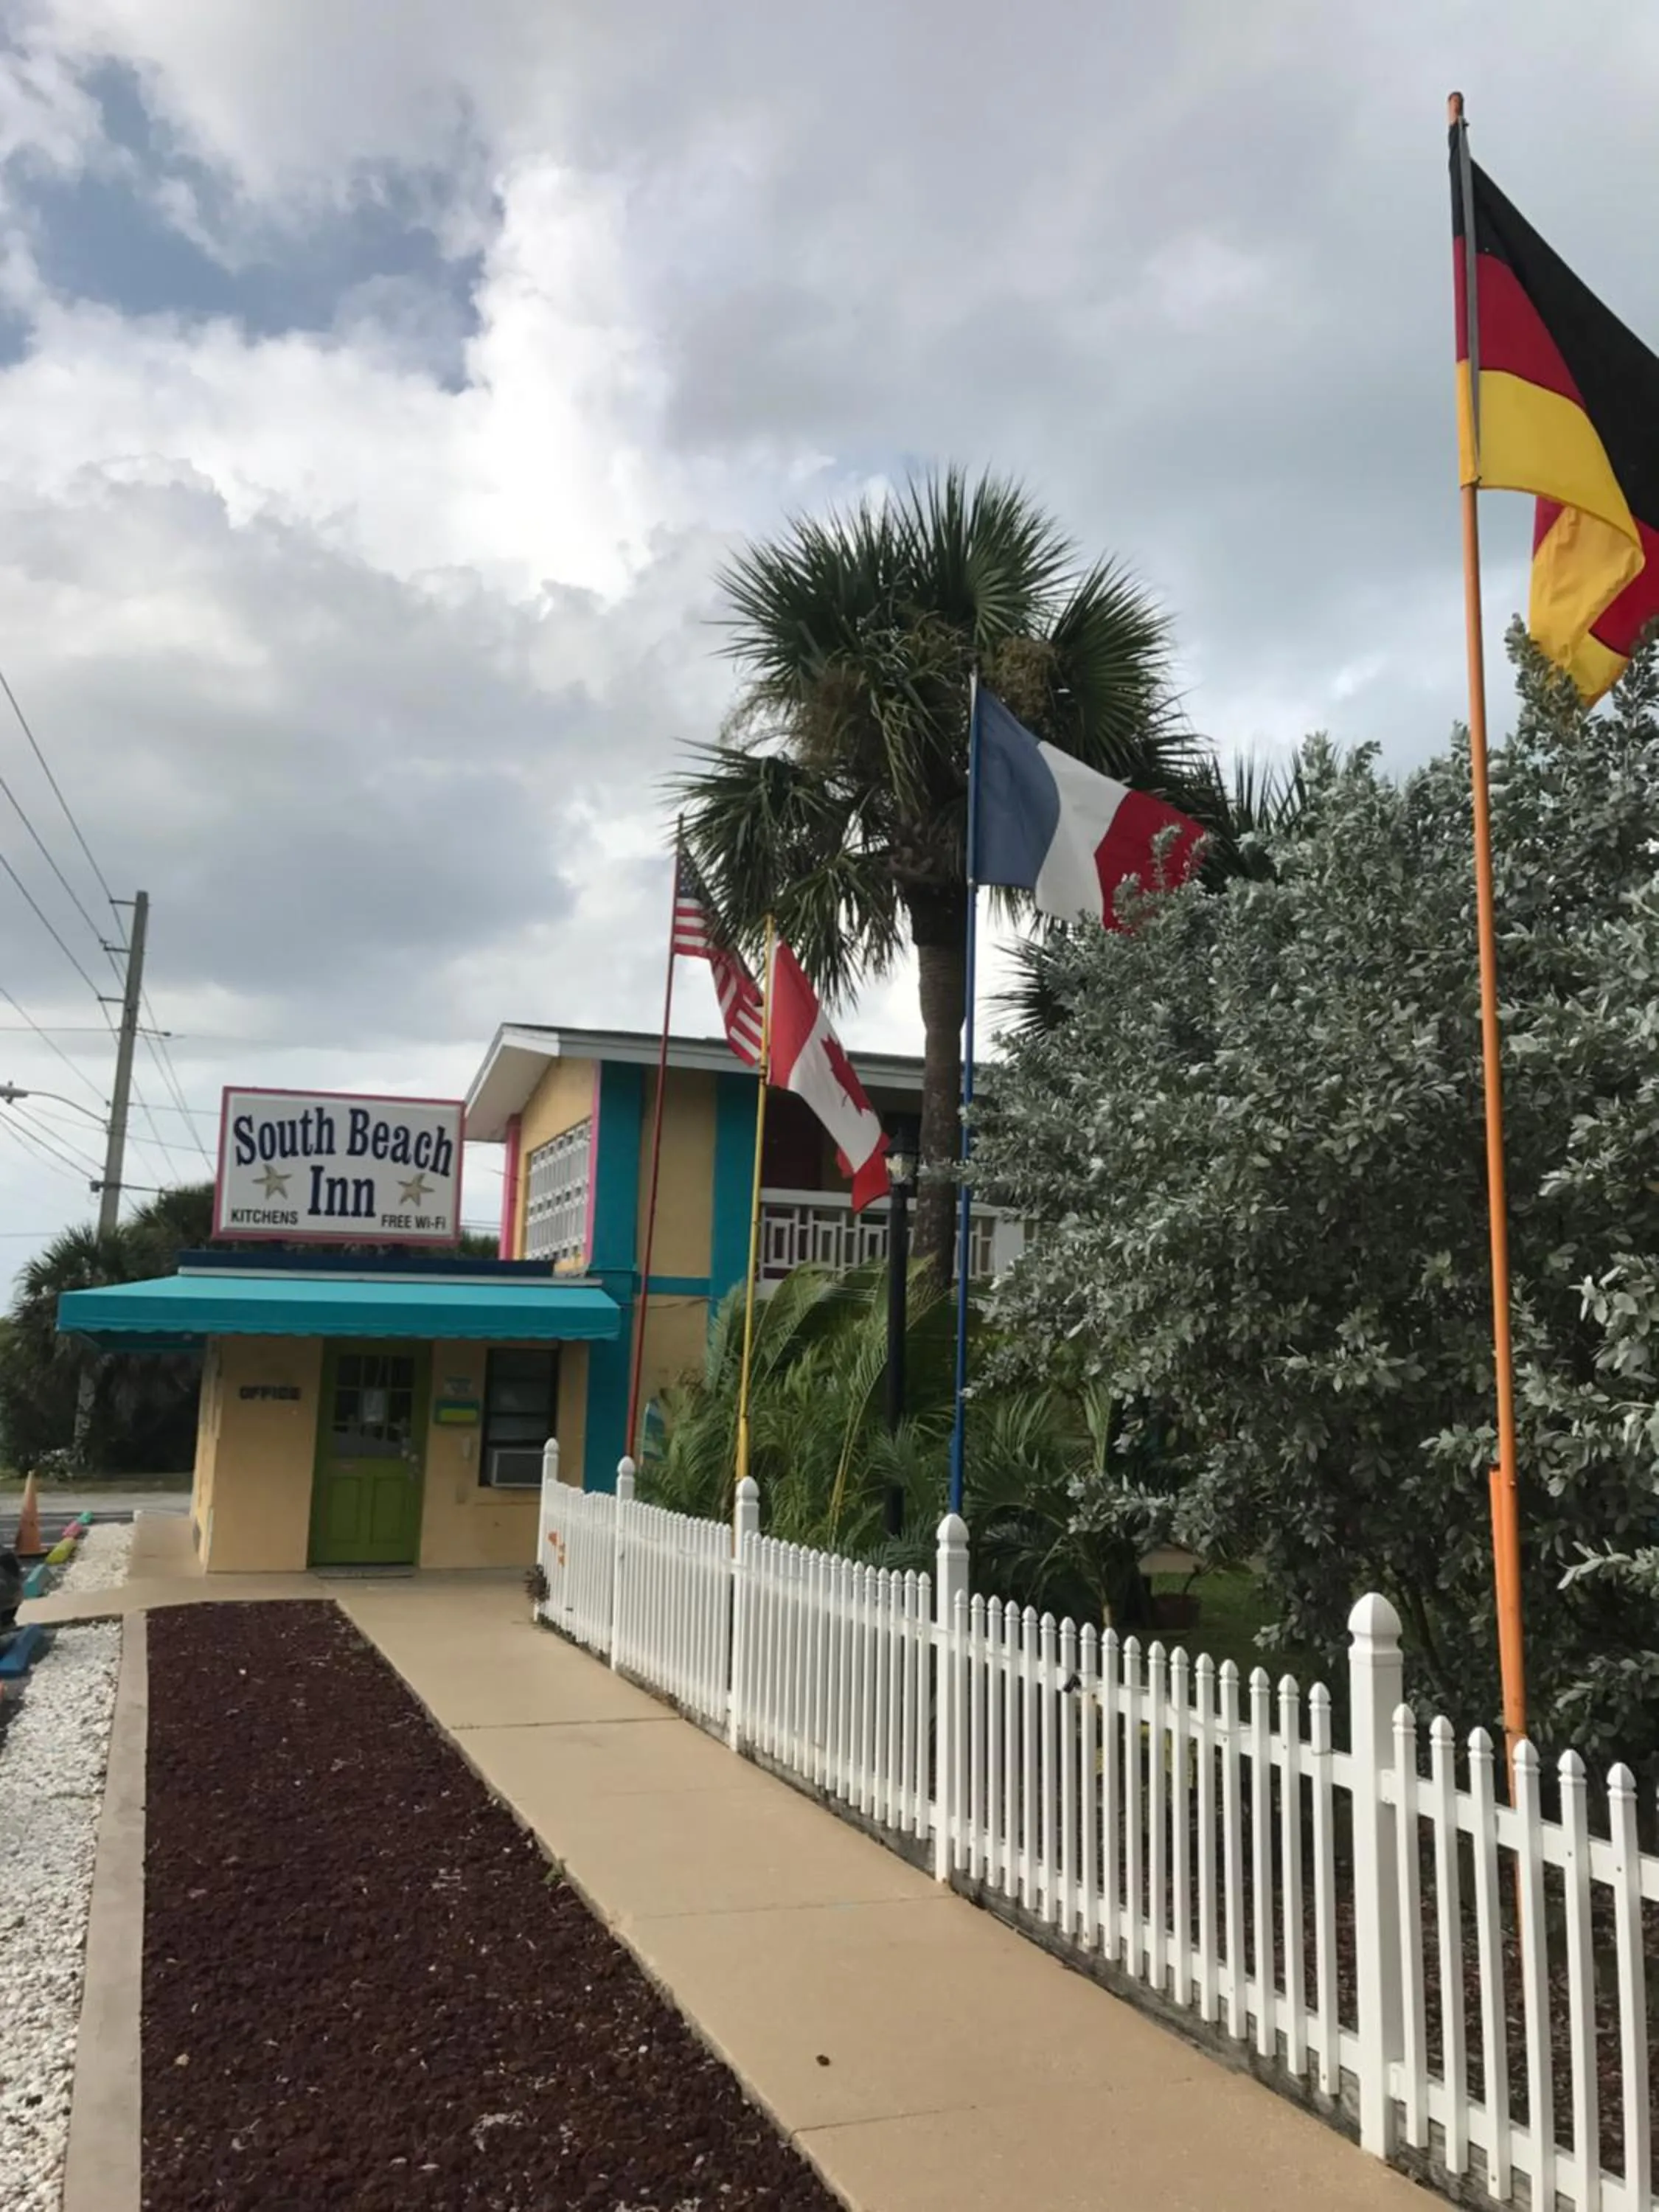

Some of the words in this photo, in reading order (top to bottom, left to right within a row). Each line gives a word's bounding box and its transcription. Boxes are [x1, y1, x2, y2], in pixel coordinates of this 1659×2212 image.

[233, 1107, 336, 1166] South
[347, 1108, 453, 1178] Beach
[307, 1165, 375, 1217] Inn
[231, 1208, 299, 1225] KITCHENS
[381, 1214, 412, 1228] FREE
